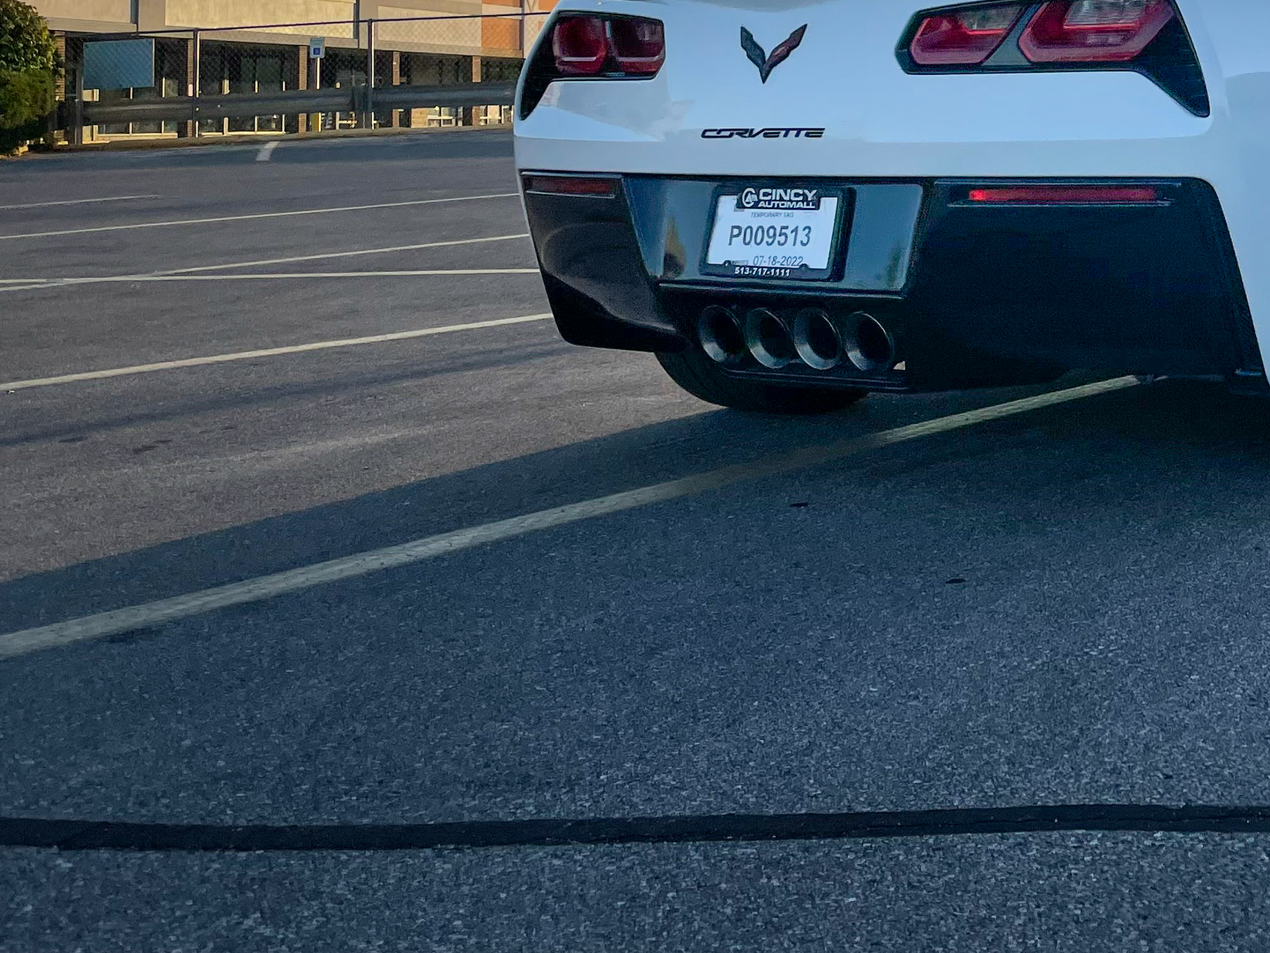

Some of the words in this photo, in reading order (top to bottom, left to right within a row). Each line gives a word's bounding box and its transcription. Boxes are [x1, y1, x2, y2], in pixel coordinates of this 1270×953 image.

[701, 128, 826, 139] CORVETTE
[760, 189, 818, 201] CINCY
[758, 200, 815, 209] AUTOMALL
[728, 225, 812, 247] P009513
[752, 255, 804, 267] 07-18-2022
